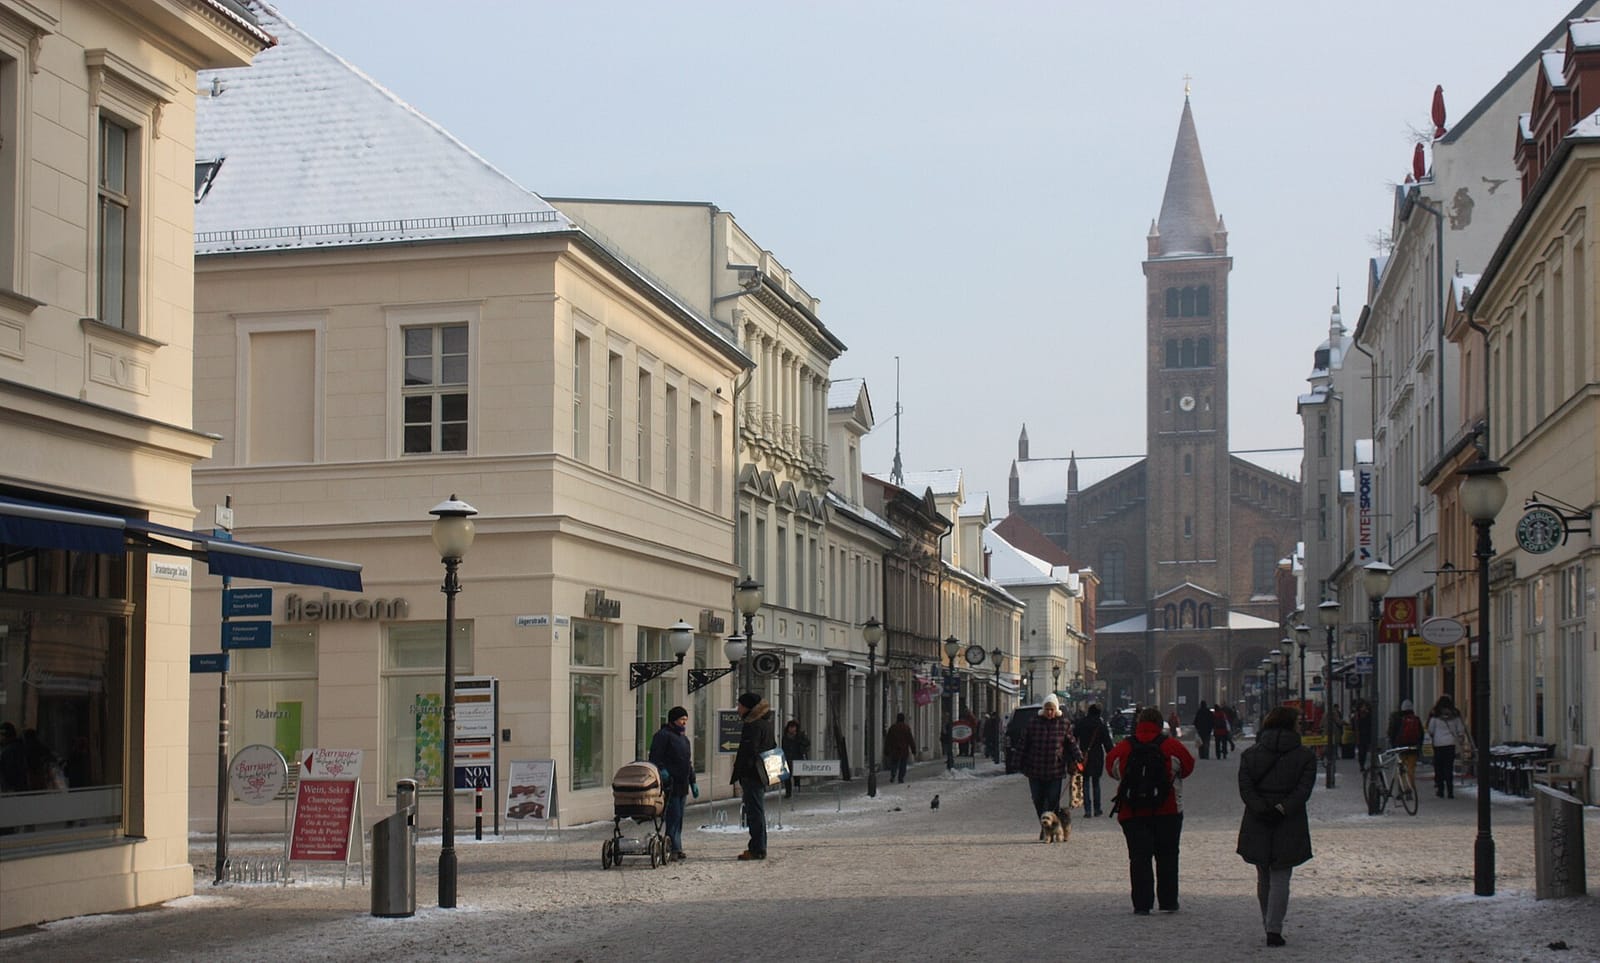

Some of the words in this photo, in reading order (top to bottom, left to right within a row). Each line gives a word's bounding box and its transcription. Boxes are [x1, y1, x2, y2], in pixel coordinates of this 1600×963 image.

[1360, 469, 1371, 546] INTERSPORT
[1519, 512, 1559, 531] STARBUCKS
[1524, 540, 1555, 551] COFFEE
[518, 616, 547, 626] Jägerstraße
[465, 768, 489, 777] NOA
[304, 785, 325, 794] Wein,
